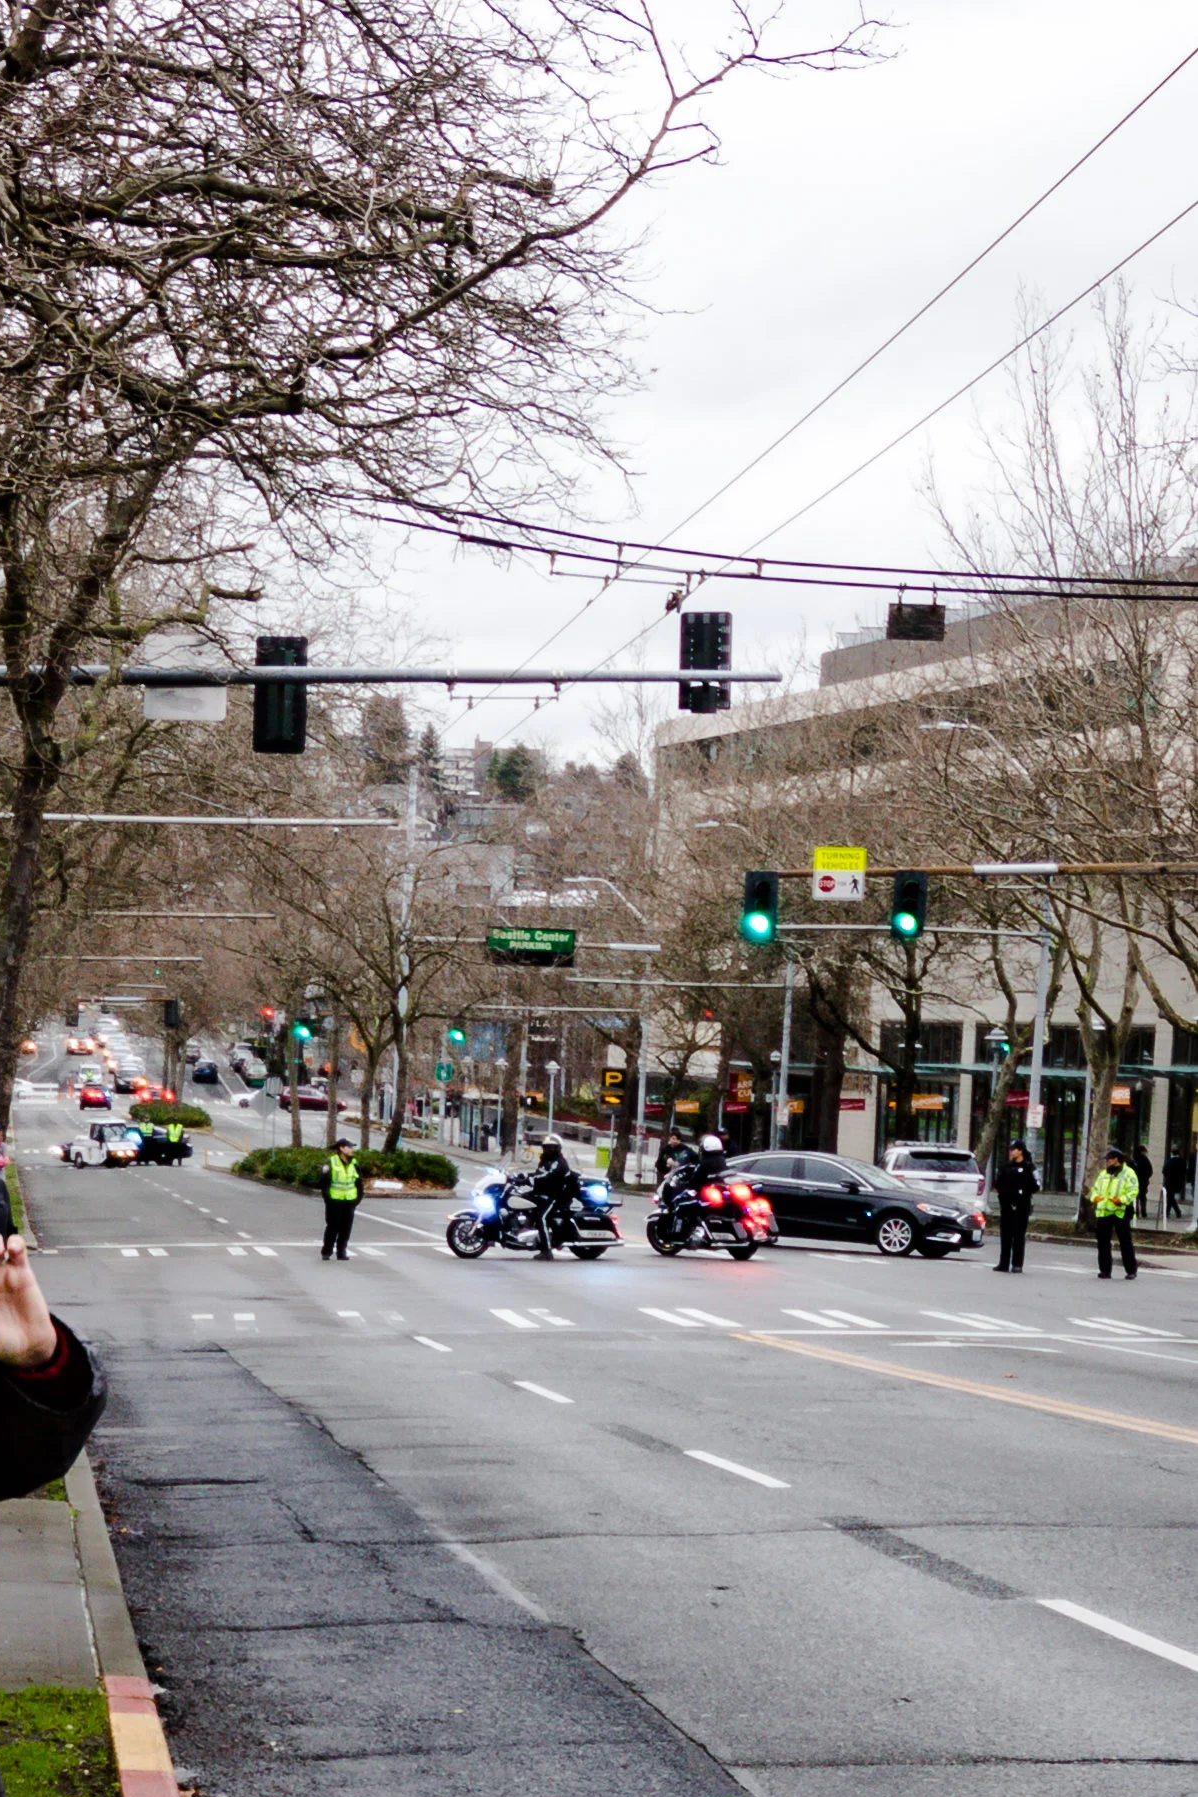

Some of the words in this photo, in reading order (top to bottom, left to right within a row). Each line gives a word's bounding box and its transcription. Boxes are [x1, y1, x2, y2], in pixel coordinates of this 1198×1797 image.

[821, 862, 858, 870] VEHICLES
[492, 929, 531, 940] Seattle
[535, 931, 570, 942] Center
[509, 941, 552, 950] PARKING
[605, 1071, 623, 1087] P
